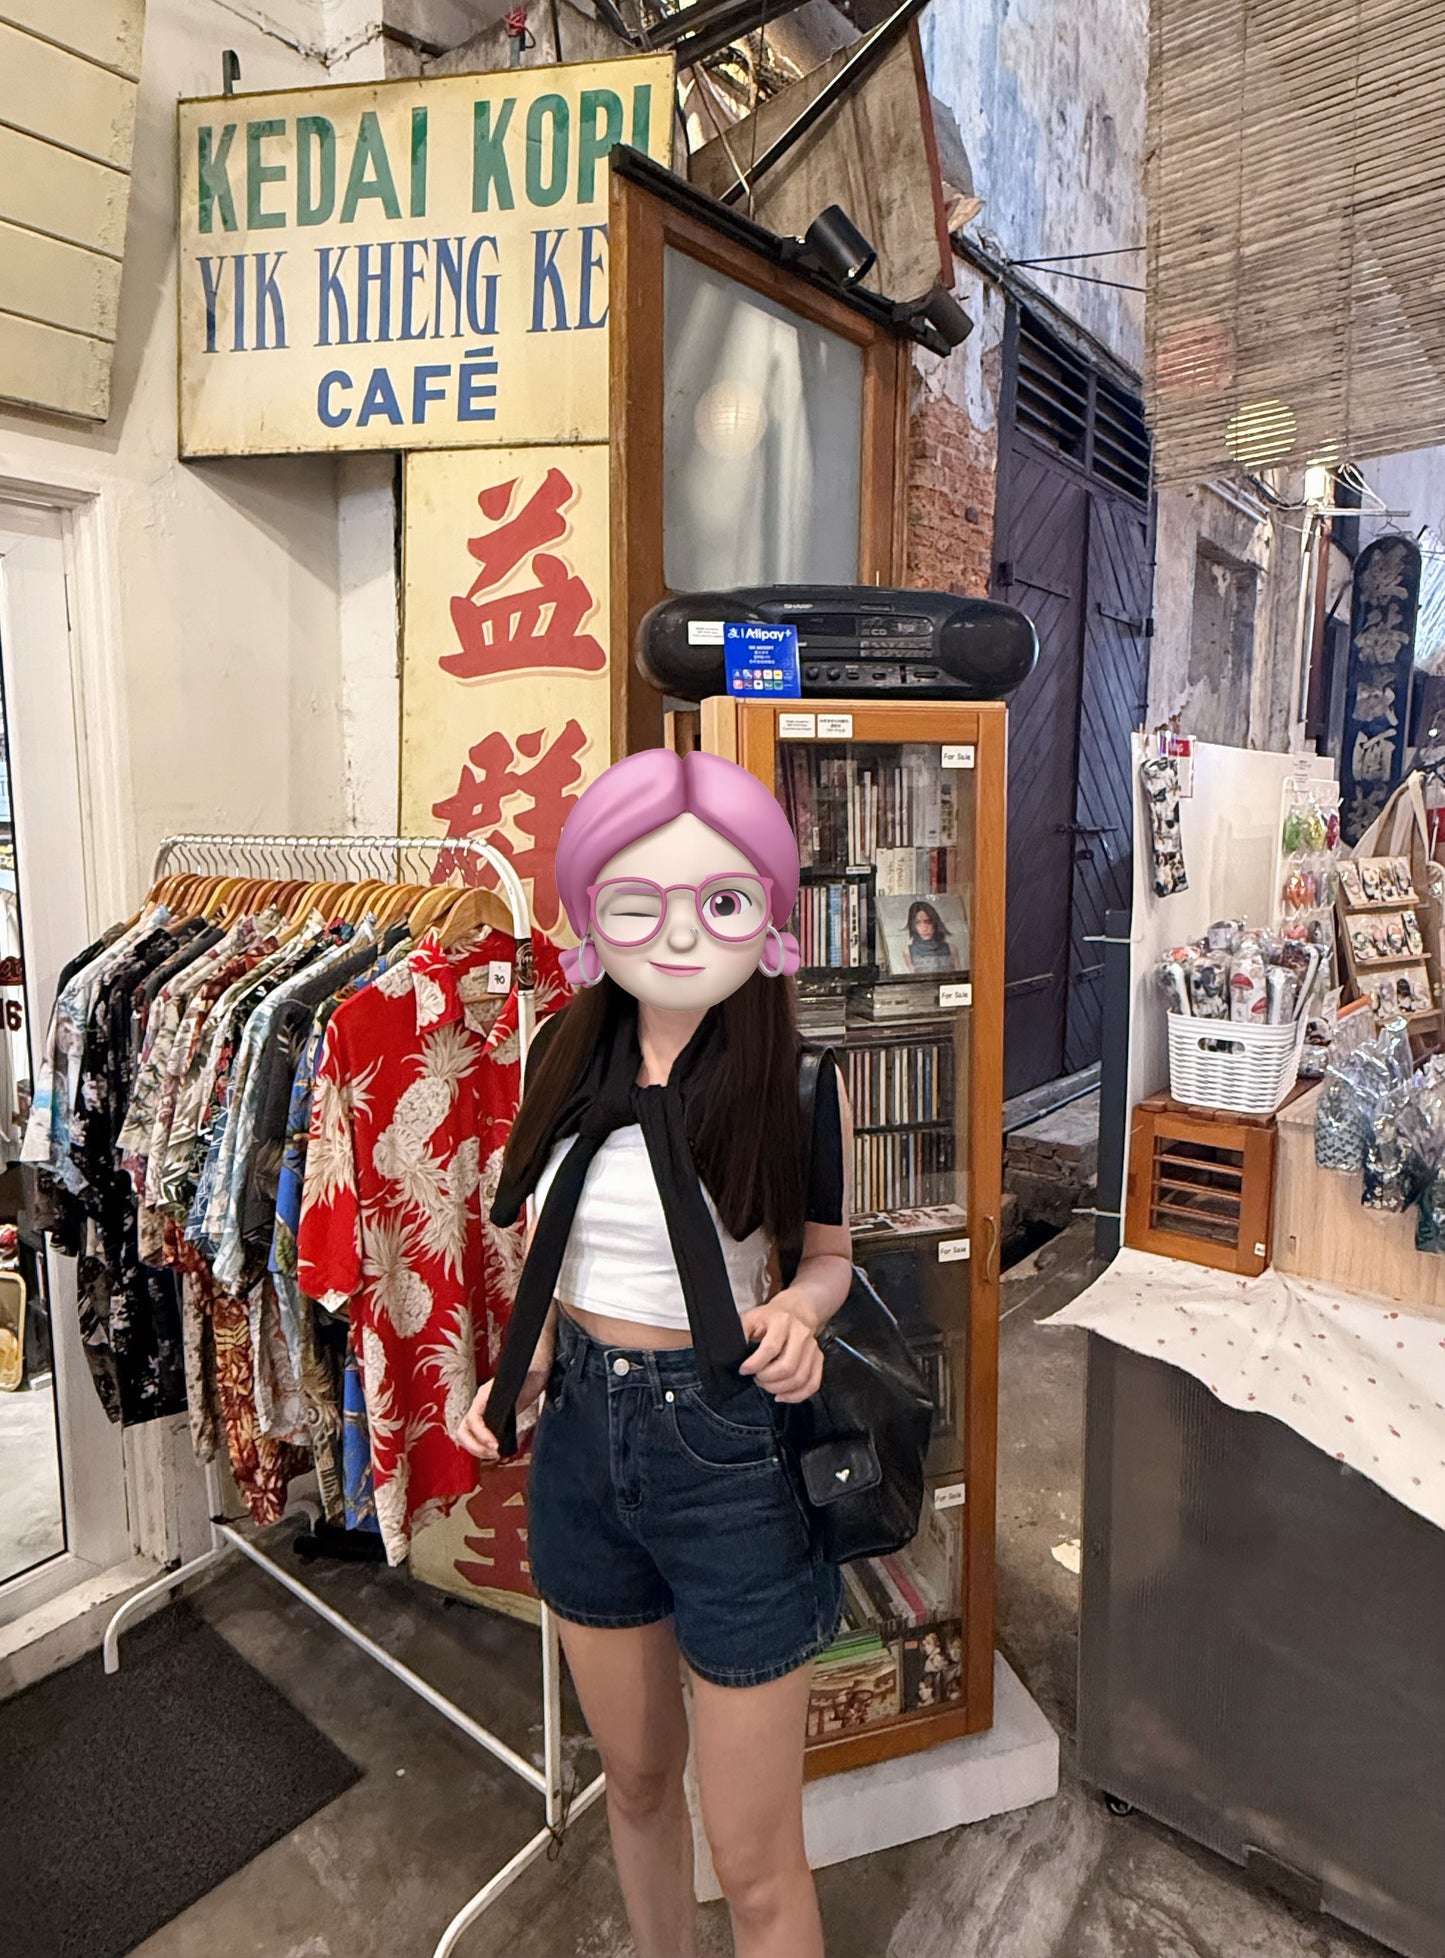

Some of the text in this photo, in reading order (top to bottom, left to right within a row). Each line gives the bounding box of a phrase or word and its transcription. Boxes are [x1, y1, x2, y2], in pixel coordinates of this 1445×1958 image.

[197, 84, 653, 234] KEDAI KOPI
[196, 250, 290, 354] YIK
[313, 235, 502, 347] KHENG
[943, 752, 971, 760] For Sale
[954, 991, 968, 999] Sale
[953, 1246, 967, 1254] Sale
[935, 1492, 962, 1503] For Sale
